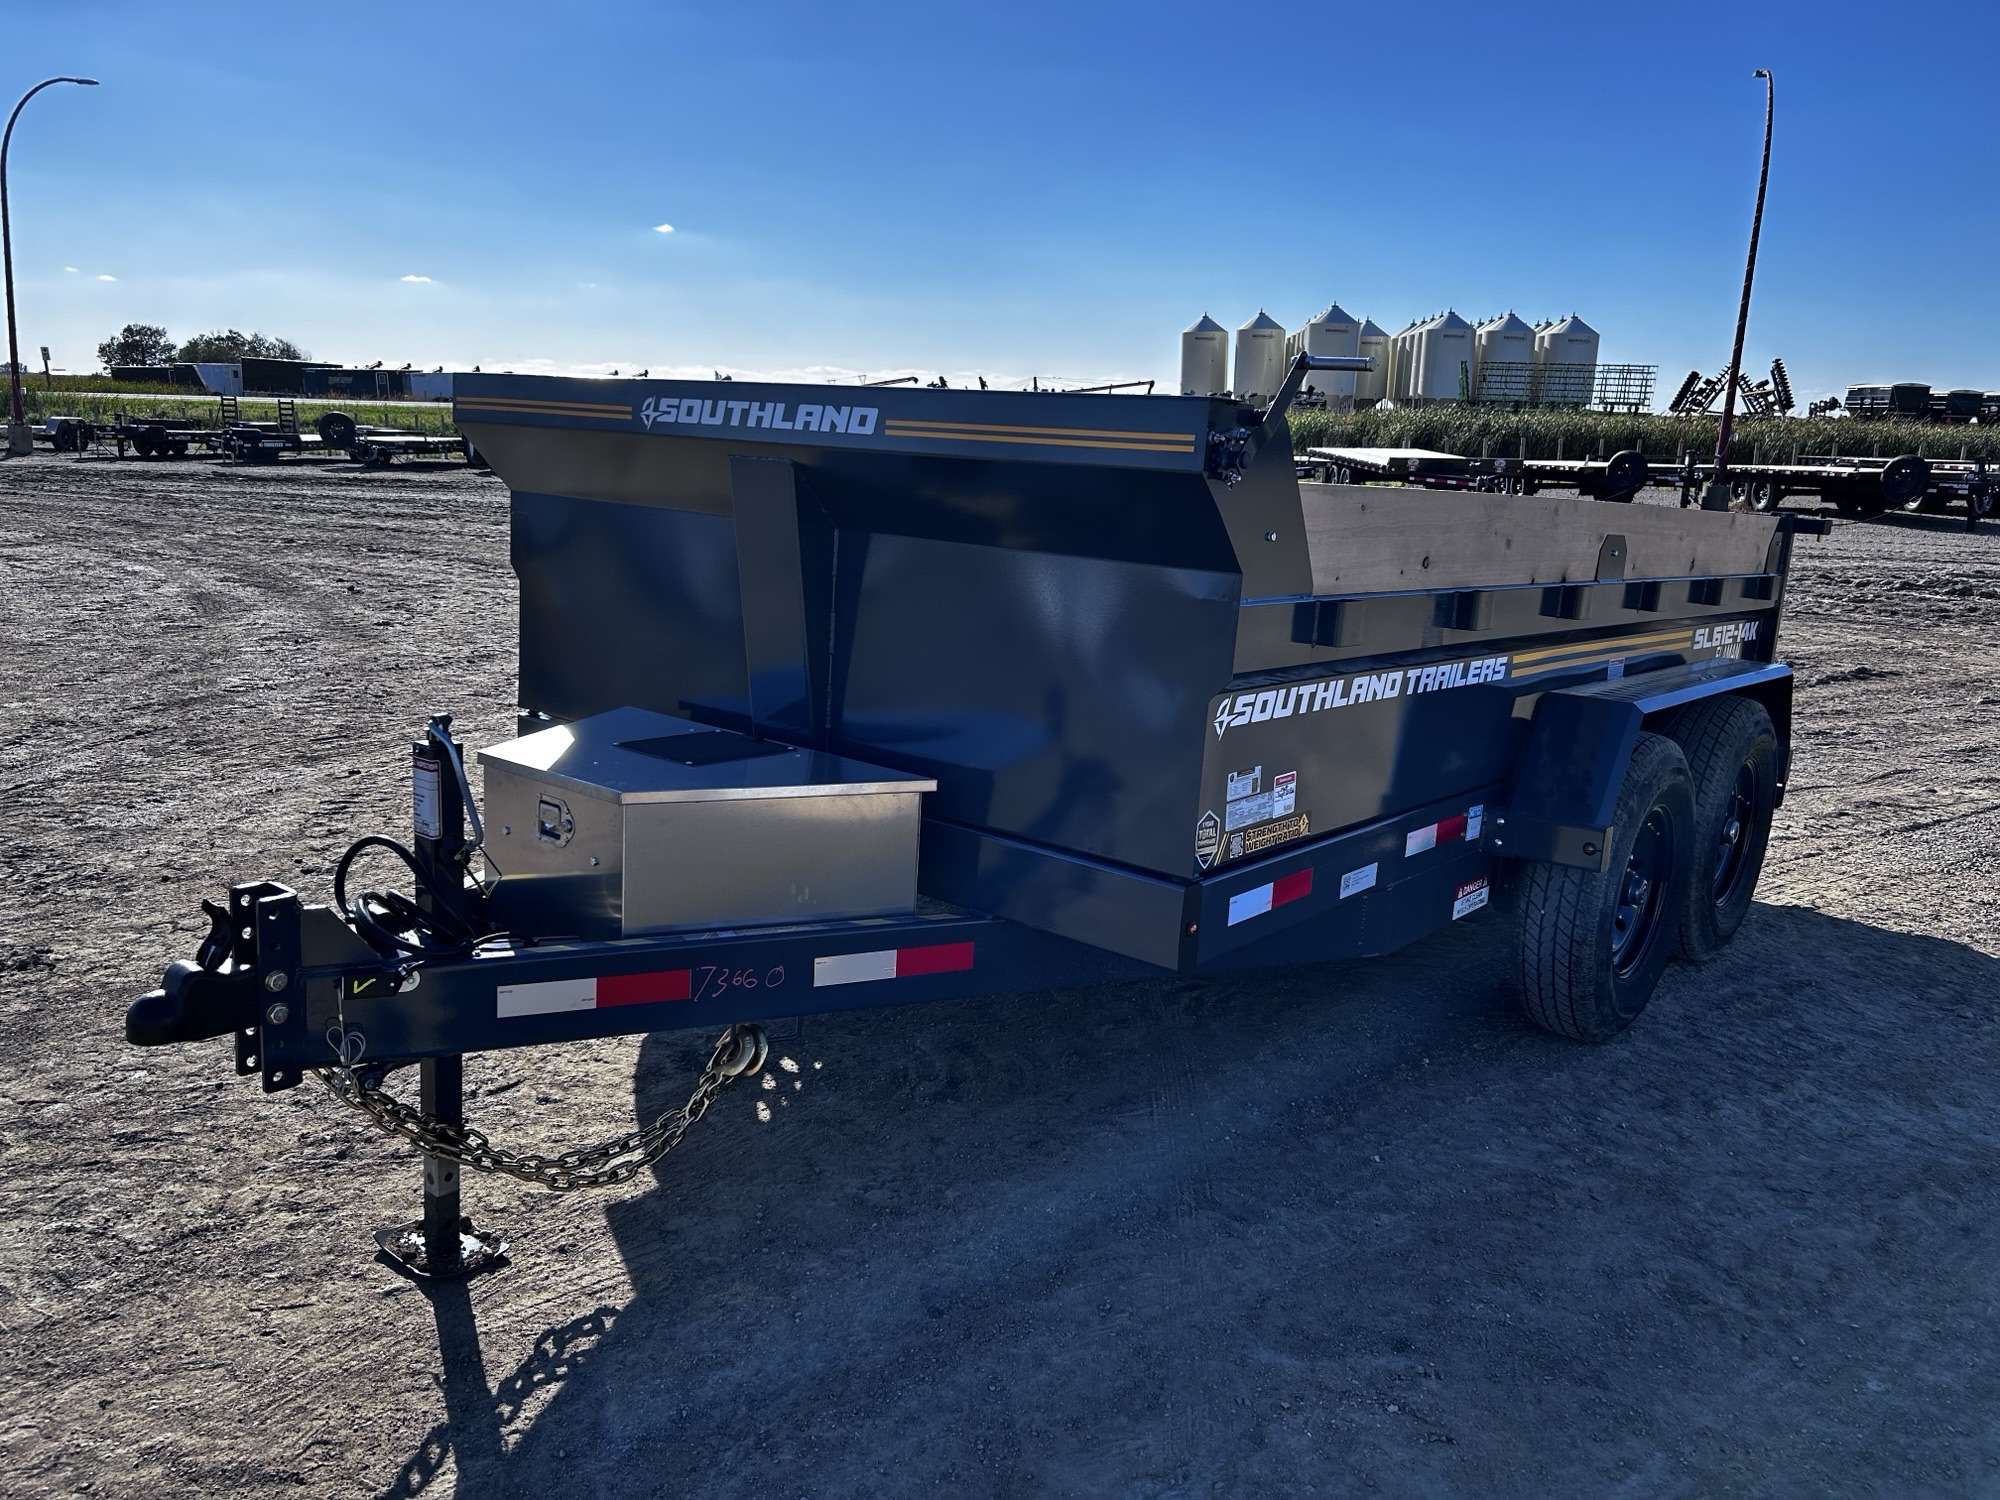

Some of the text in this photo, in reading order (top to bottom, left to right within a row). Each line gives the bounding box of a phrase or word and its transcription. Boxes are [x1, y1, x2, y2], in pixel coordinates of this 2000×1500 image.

[656, 397, 879, 435] SOUTHLAND
[1693, 621, 1759, 650] SL612-14K
[1230, 656, 1508, 727] SOUTHLAND TRAILERS
[1246, 820, 1289, 842] STRENGTH
[1246, 832, 1276, 853] WEIGHT
